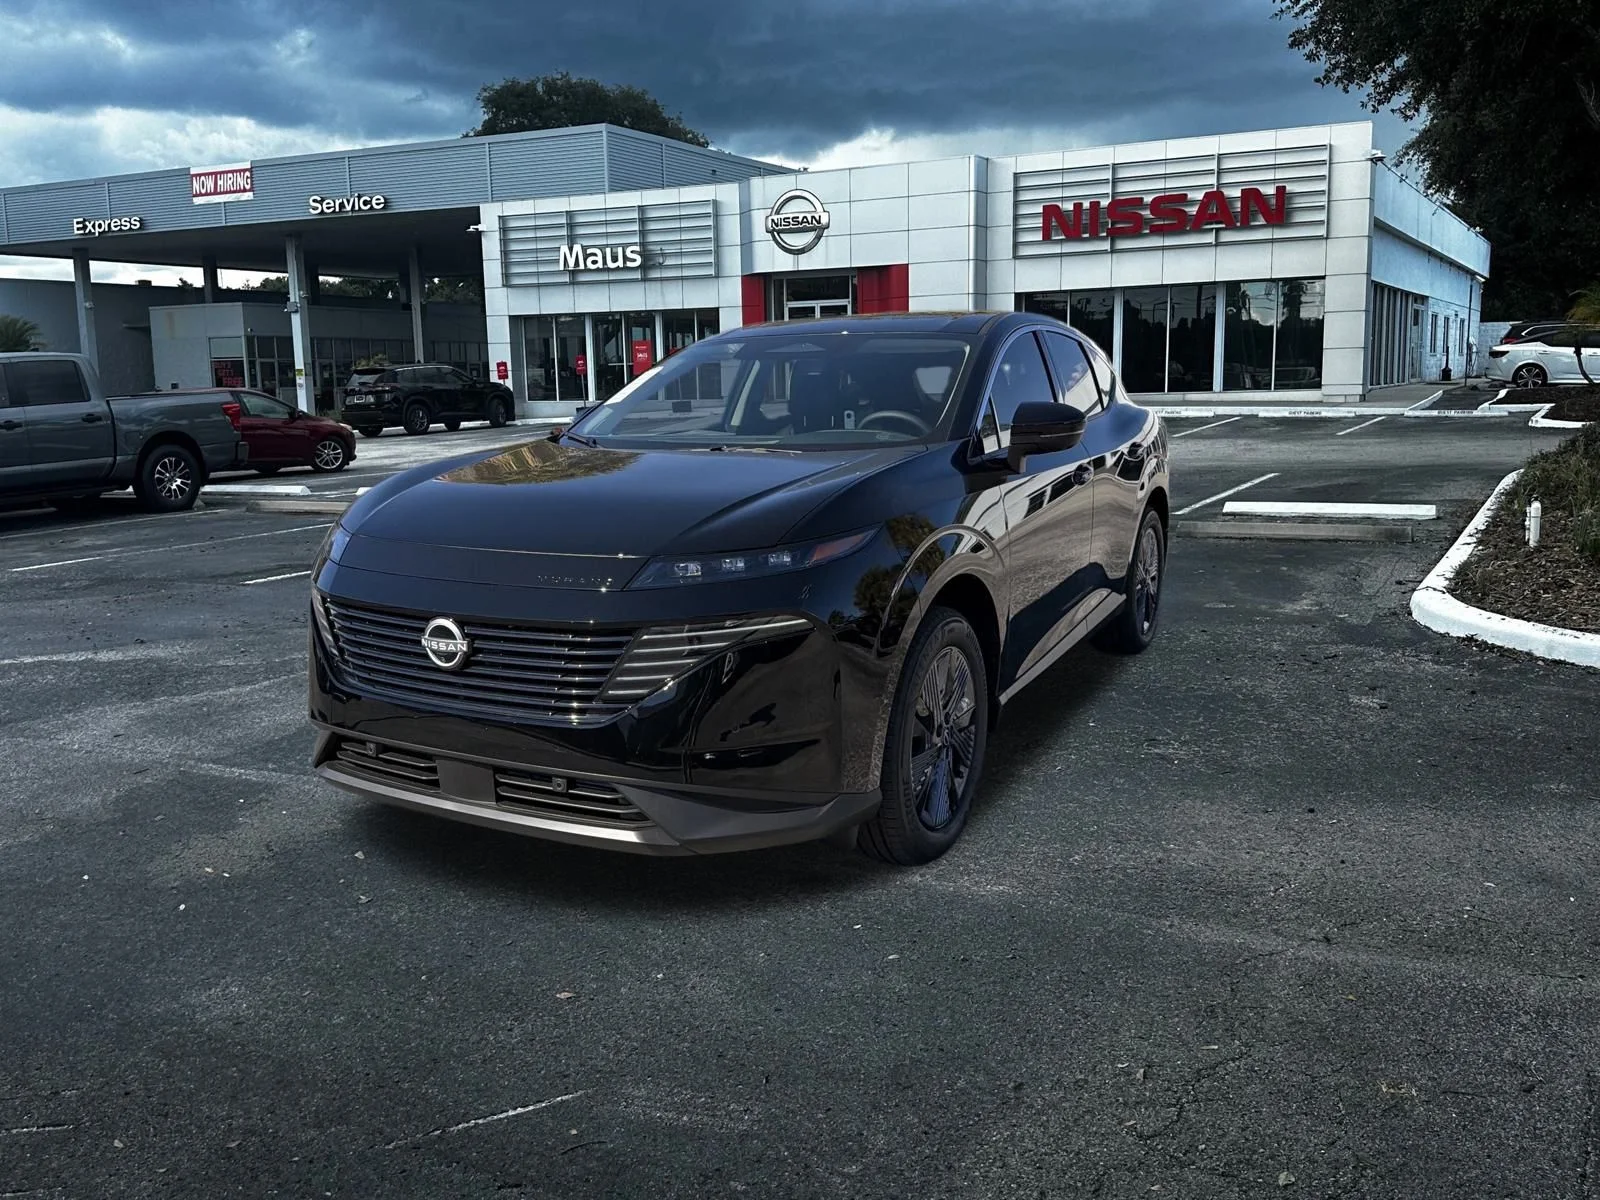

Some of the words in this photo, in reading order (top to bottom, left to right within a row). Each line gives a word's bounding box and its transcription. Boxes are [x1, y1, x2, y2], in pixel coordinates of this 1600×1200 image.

[193, 175, 215, 195] NOW
[217, 171, 251, 192] HIRING
[309, 193, 385, 214] Service
[1042, 185, 1287, 241] NISSAN
[73, 216, 140, 236] Express
[770, 215, 821, 228] NISSAN
[559, 244, 641, 270] Maus
[421, 638, 467, 651] NISSAN
